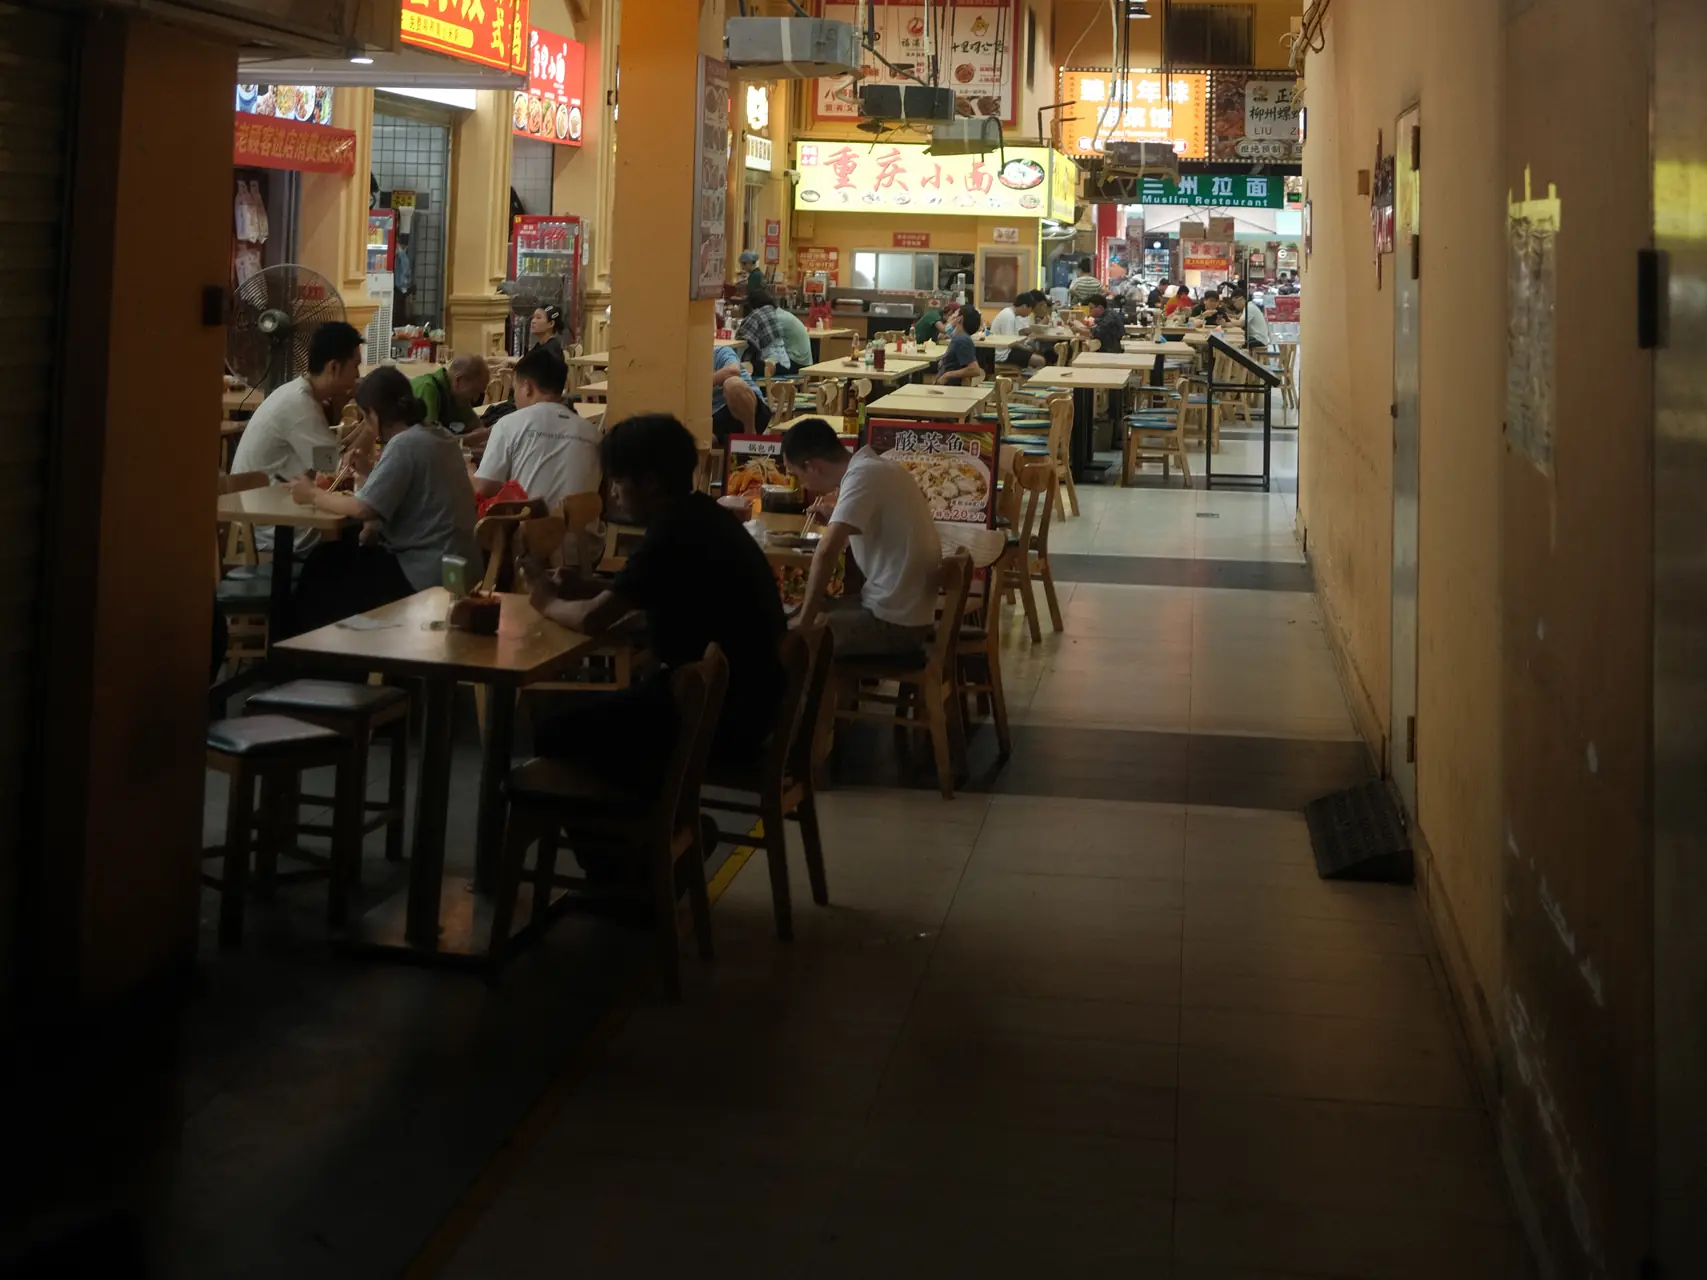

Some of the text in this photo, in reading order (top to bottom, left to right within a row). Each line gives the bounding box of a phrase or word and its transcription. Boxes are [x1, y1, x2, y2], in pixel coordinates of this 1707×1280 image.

[1254, 127, 1272, 135] LIU
[823, 146, 993, 195] 重庆小面
[1143, 176, 1268, 197] 兰州拉面
[1142, 195, 1269, 207] Muslim Restaurant
[748, 443, 776, 454] 锅包肉
[895, 430, 965, 455] 酸菜鱼
